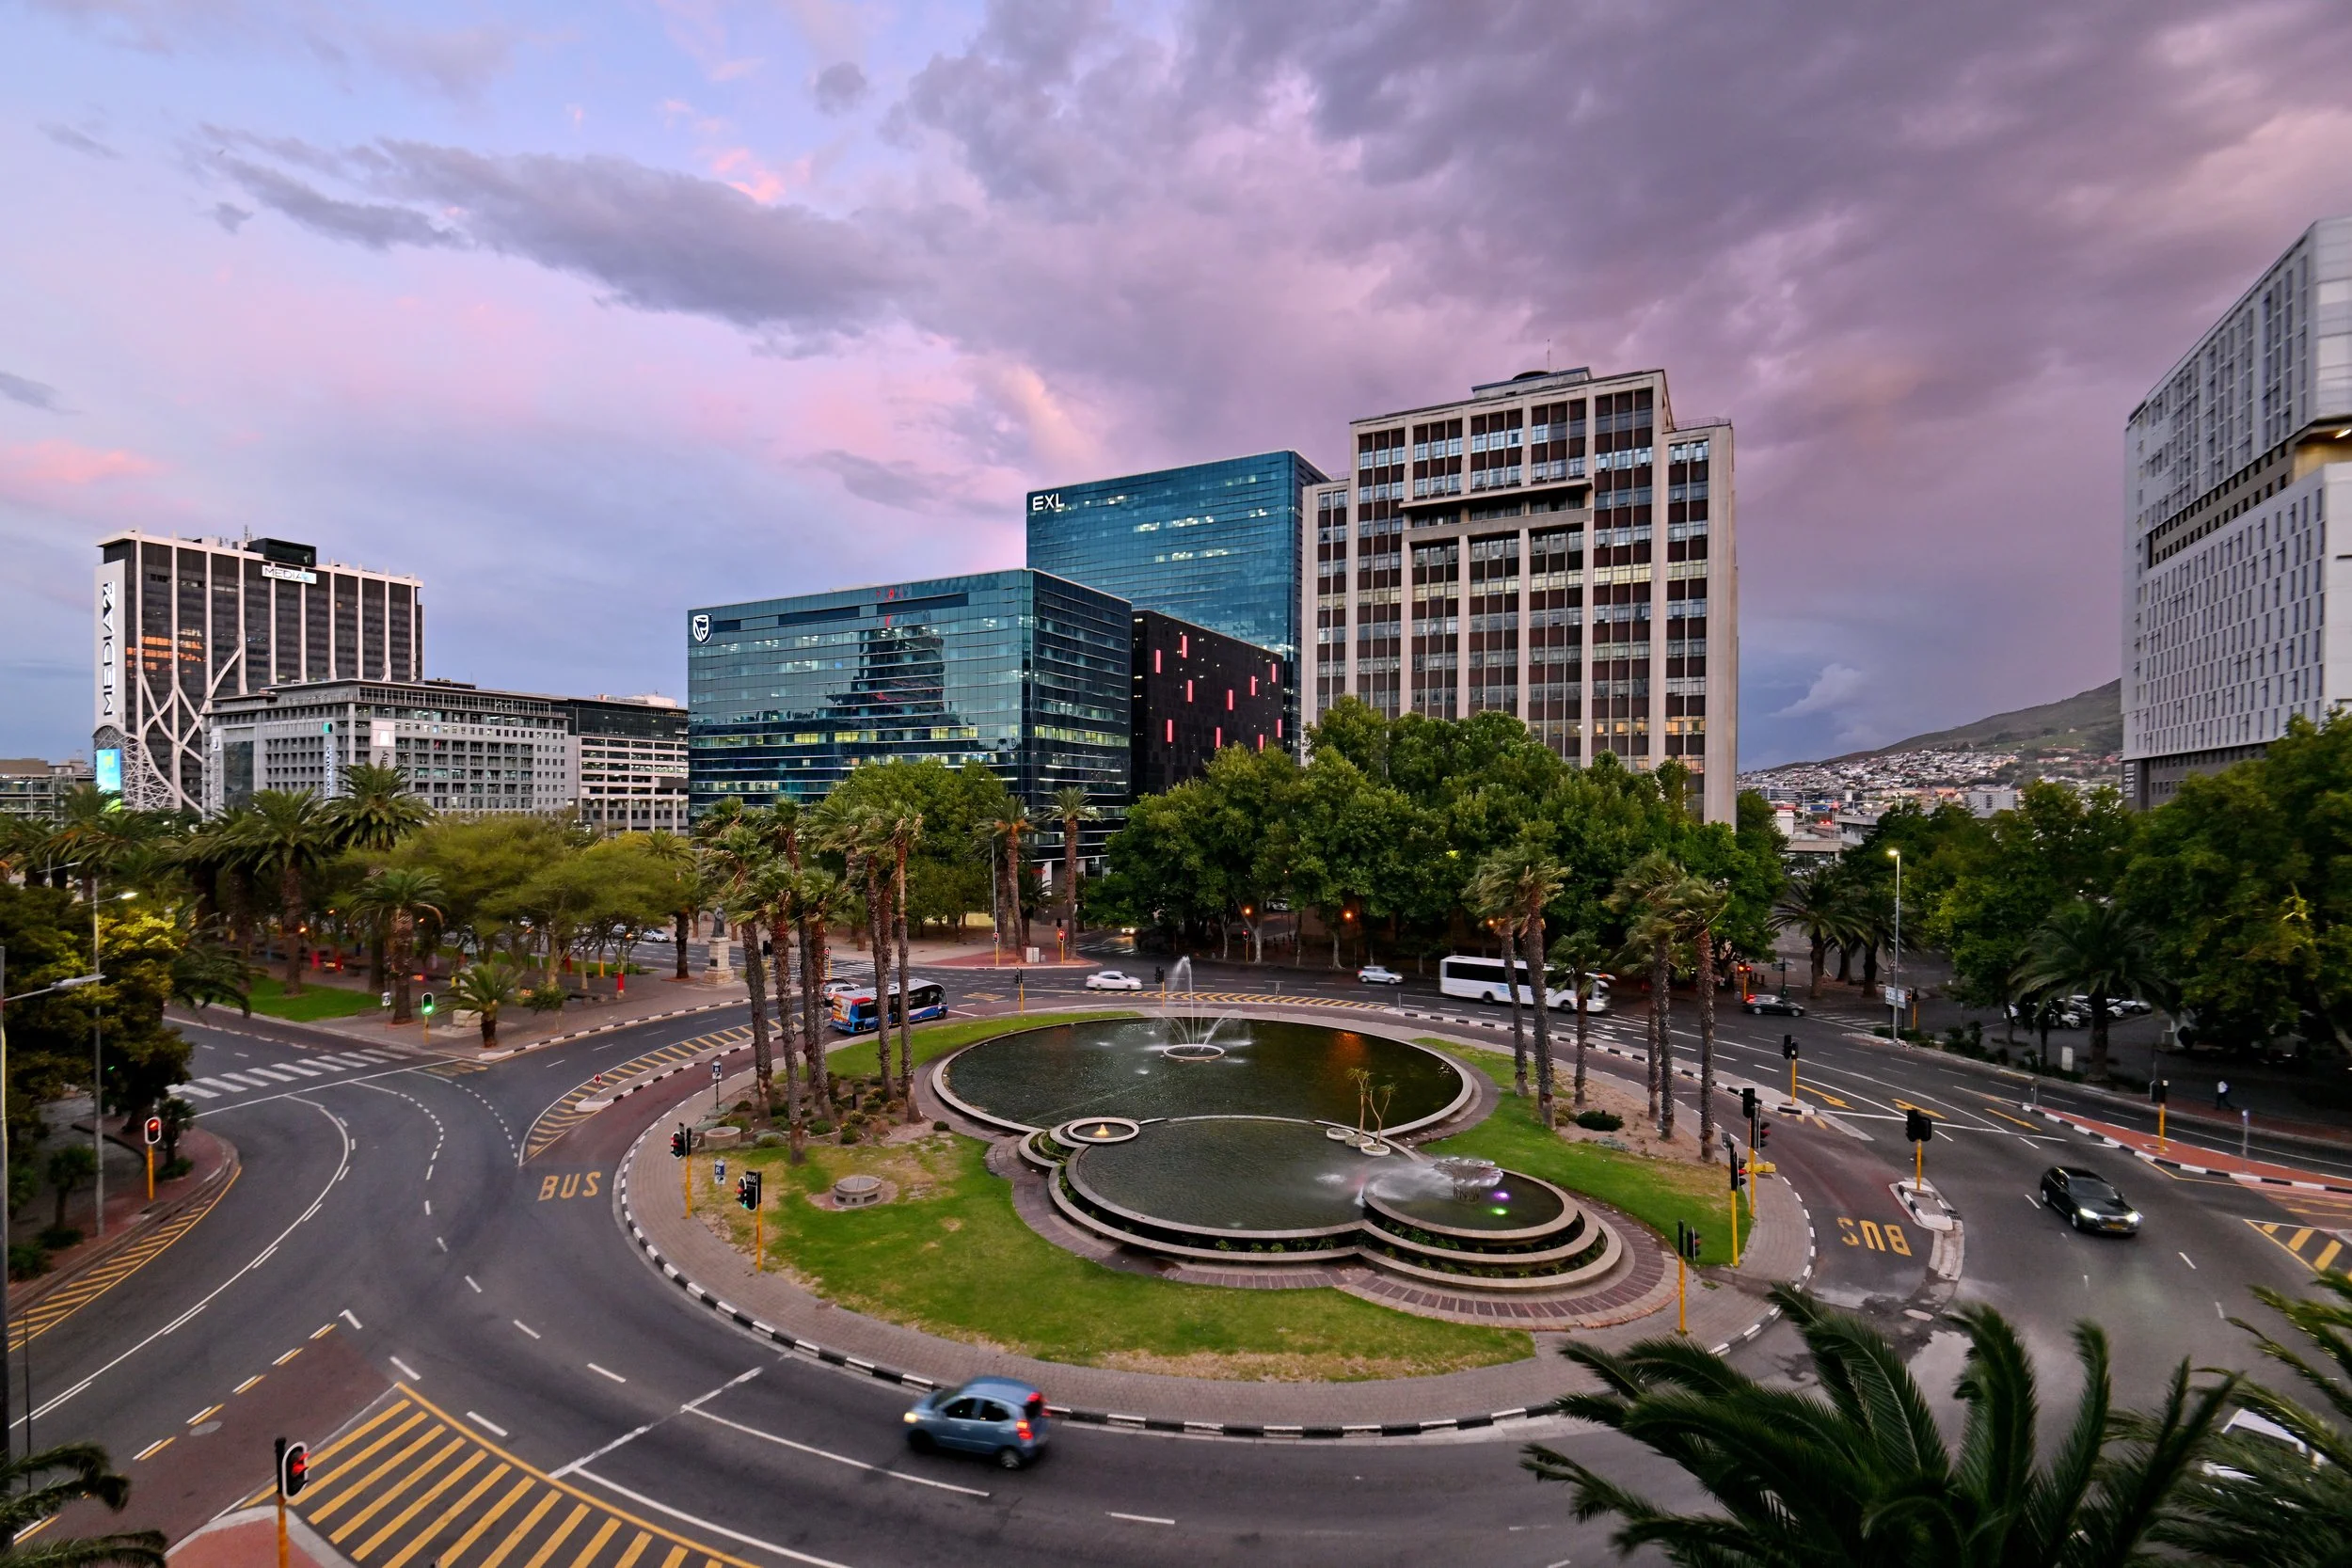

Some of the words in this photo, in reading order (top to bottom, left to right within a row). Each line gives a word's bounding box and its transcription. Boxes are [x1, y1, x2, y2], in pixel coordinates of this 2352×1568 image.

[1032, 493, 1065, 512] EXL
[103, 581, 115, 716] MEDIA24
[537, 1171, 601, 1201] BUS
[746, 1174, 756, 1183] BUS
[1836, 1217, 1913, 1257] BUS
